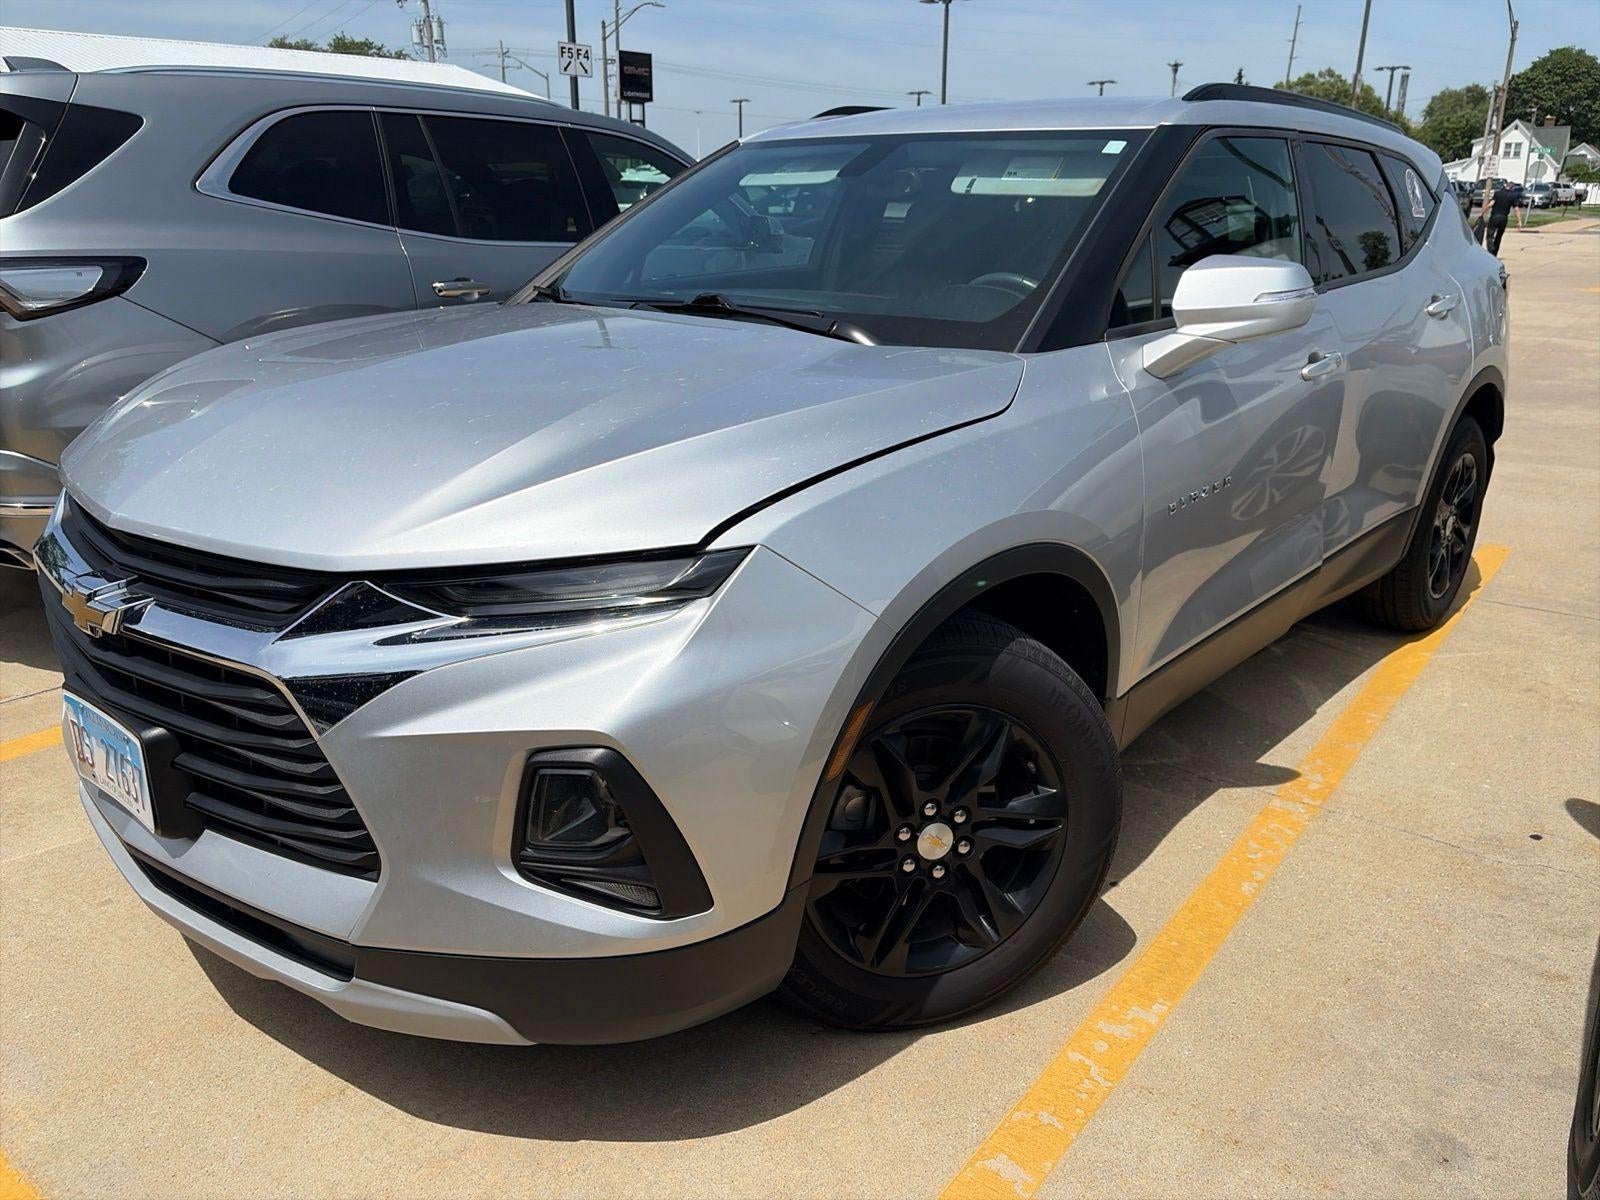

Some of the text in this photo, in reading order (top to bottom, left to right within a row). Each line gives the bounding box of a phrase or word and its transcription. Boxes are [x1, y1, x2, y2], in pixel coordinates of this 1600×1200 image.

[560, 46, 574, 59] F5
[576, 48, 590, 61] F4
[1167, 475, 1232, 516] BLAZER
